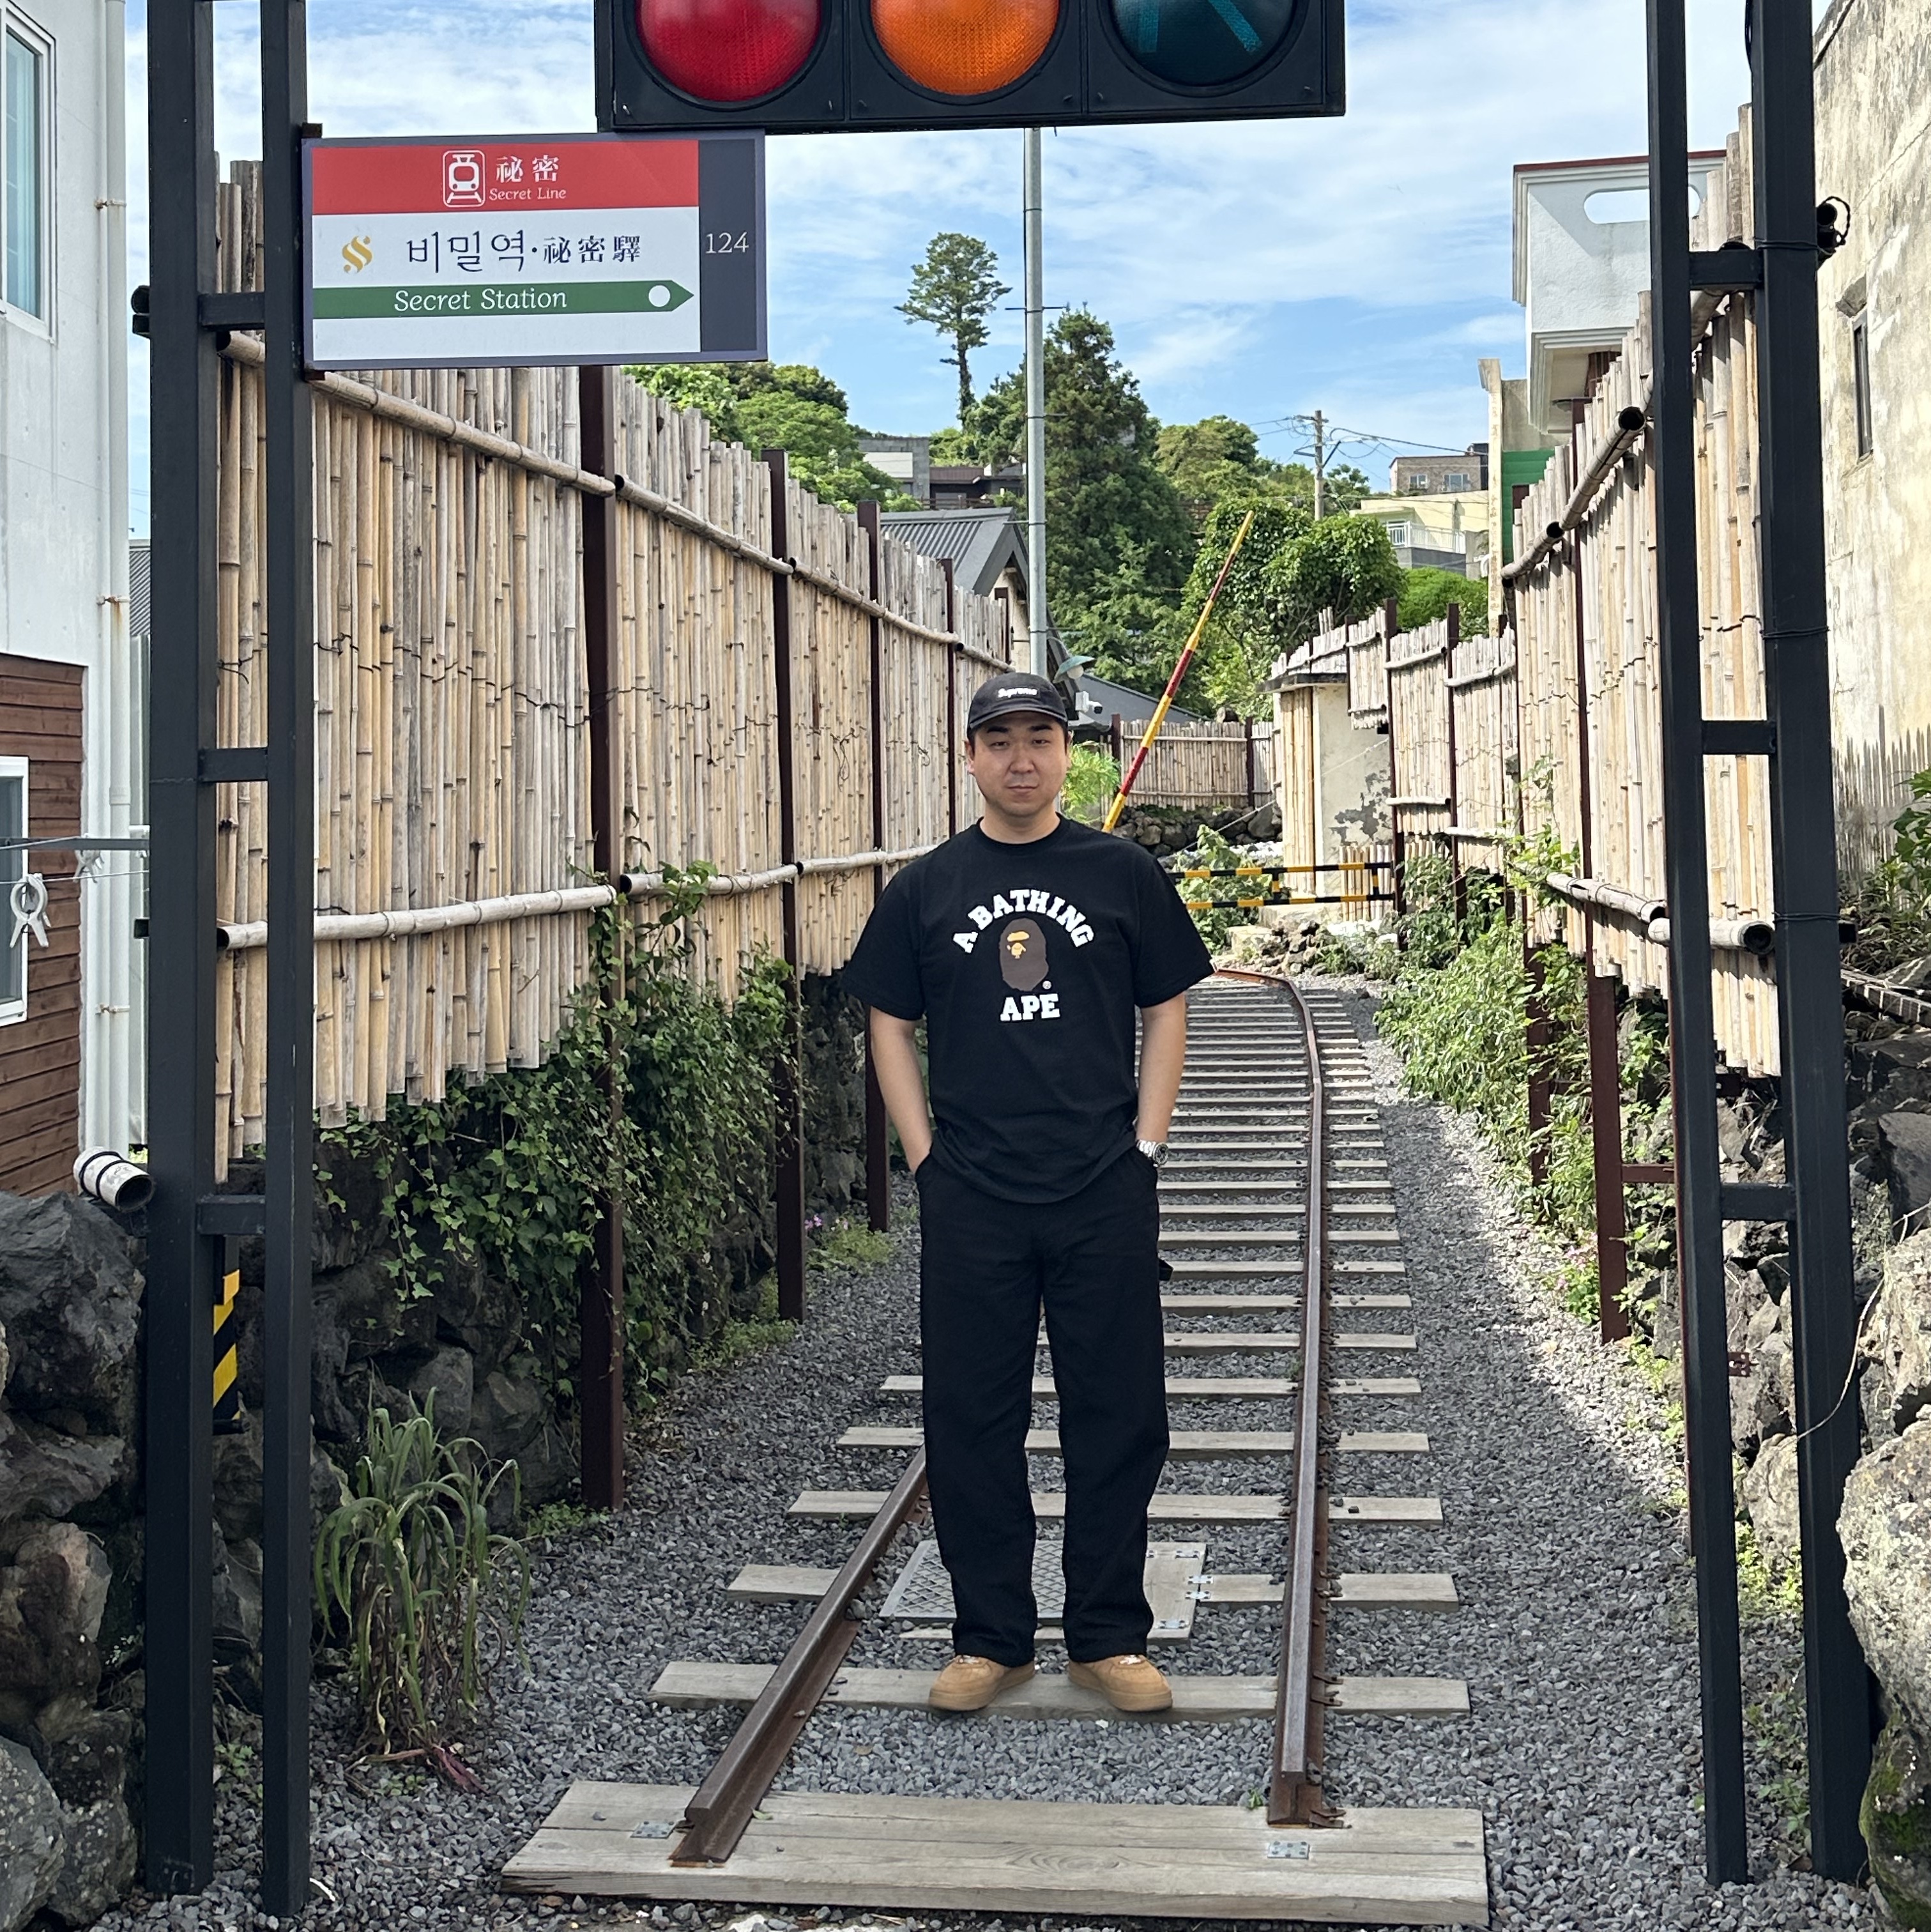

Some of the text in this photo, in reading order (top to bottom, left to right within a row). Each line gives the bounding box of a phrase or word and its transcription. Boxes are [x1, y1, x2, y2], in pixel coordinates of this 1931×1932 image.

[489, 187, 567, 201] Secret Line
[705, 231, 749, 254] 124
[393, 287, 567, 312] Secret Station
[952, 889, 1095, 954] A BATHING
[1000, 993, 1061, 1022] APE
